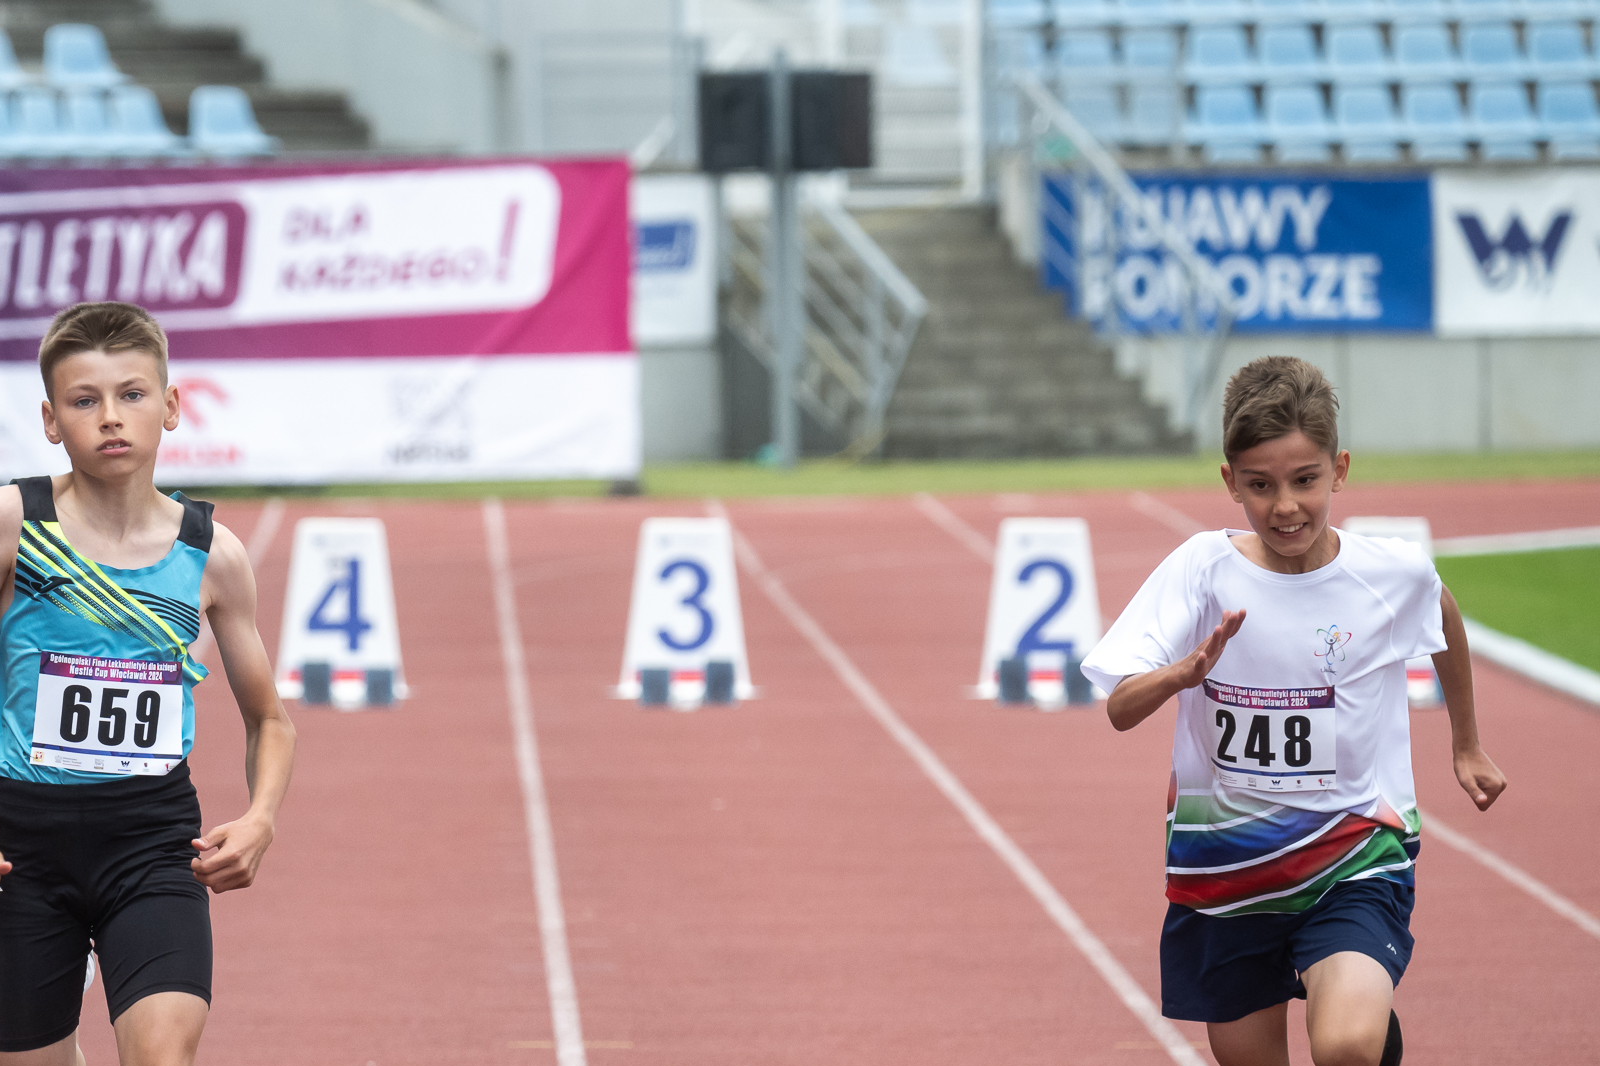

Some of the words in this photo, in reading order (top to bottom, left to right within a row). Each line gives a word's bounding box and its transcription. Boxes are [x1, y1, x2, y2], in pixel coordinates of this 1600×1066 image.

[306, 559, 372, 652] 4
[657, 560, 715, 652] 3
[1014, 559, 1077, 654] 2
[94, 667, 108, 678] Cup
[148, 671, 162, 681] 2024
[1237, 696, 1249, 706] Cup
[1290, 697, 1308, 706] 2024
[59, 684, 161, 749] 659
[1215, 709, 1312, 768] 248
